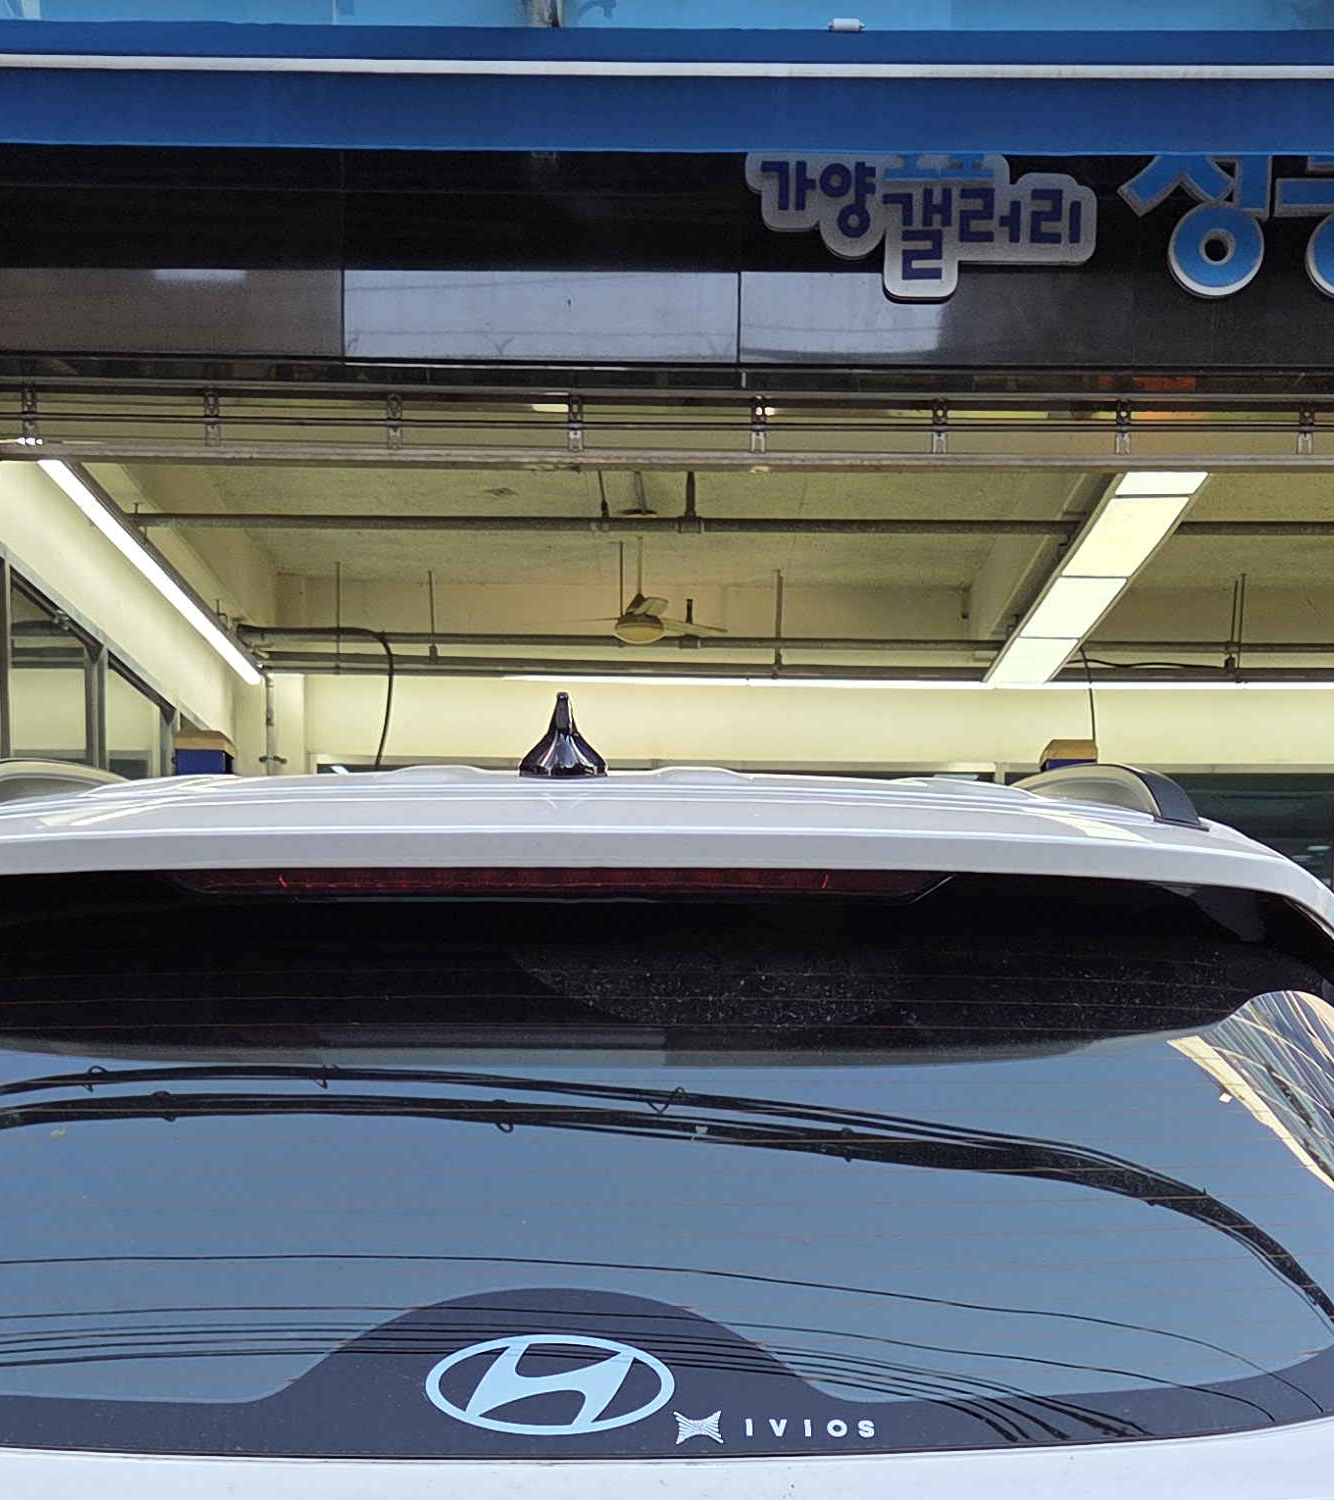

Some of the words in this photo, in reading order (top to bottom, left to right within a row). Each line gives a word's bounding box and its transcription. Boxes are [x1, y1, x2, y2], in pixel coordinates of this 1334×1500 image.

[761, 160, 875, 238] 가양
[882, 187, 1081, 281] 갤러리
[745, 1418, 876, 1438] IVIOS
